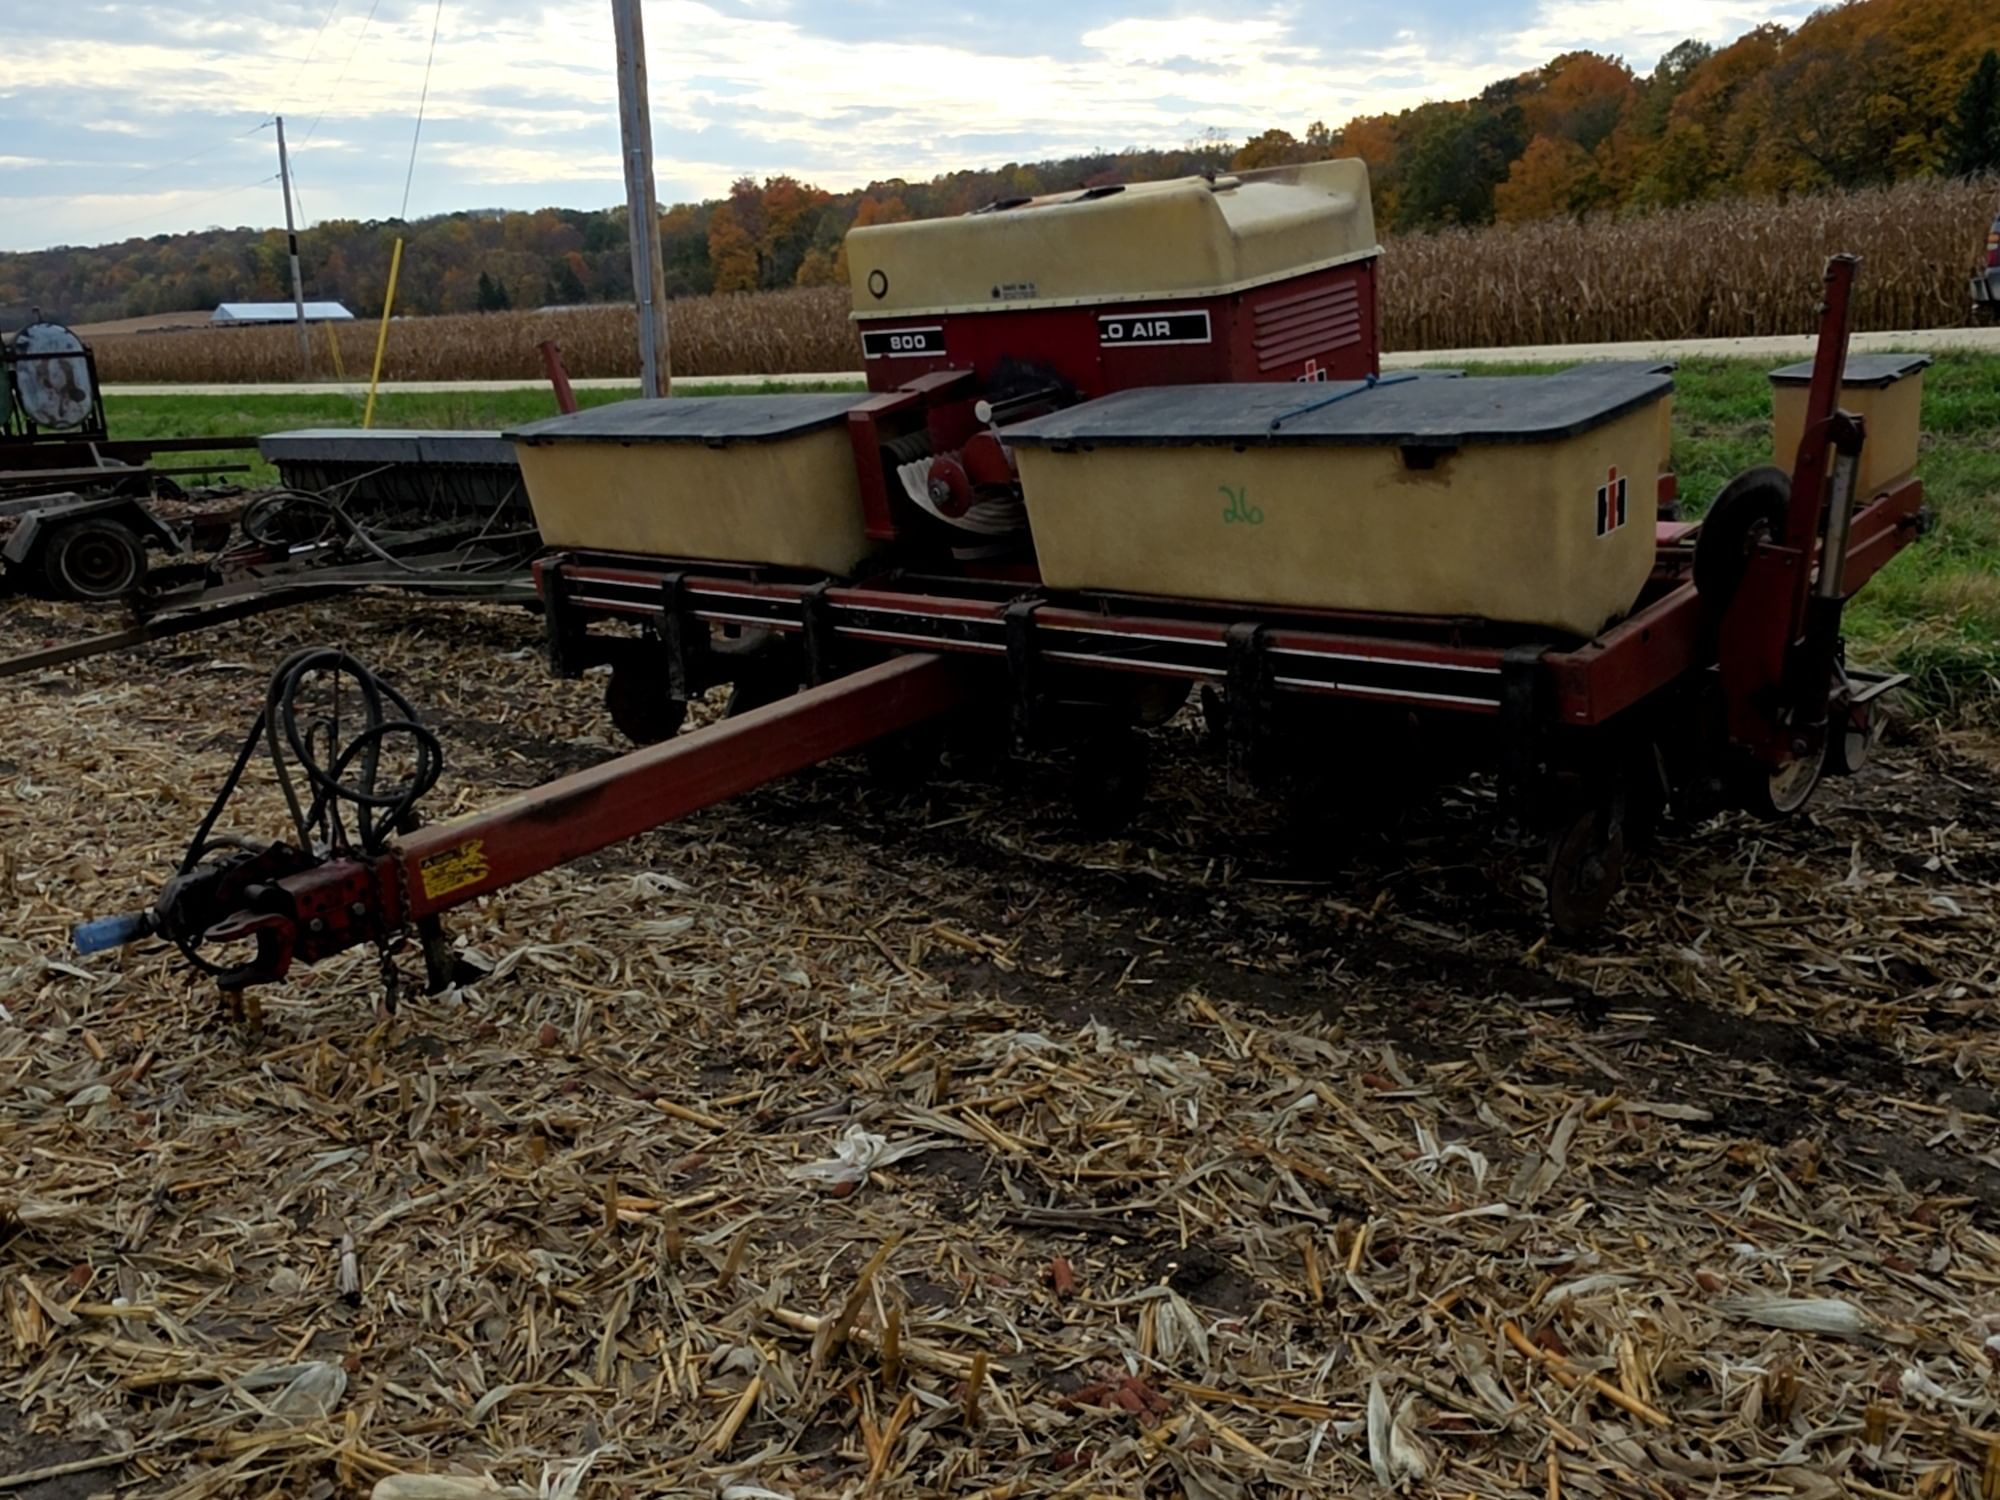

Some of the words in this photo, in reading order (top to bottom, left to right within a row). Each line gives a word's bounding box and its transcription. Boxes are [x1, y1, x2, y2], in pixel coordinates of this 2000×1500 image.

[1132, 321, 1170, 338] AIR
[890, 335, 926, 350] 800
[1218, 485, 1265, 525] 26
